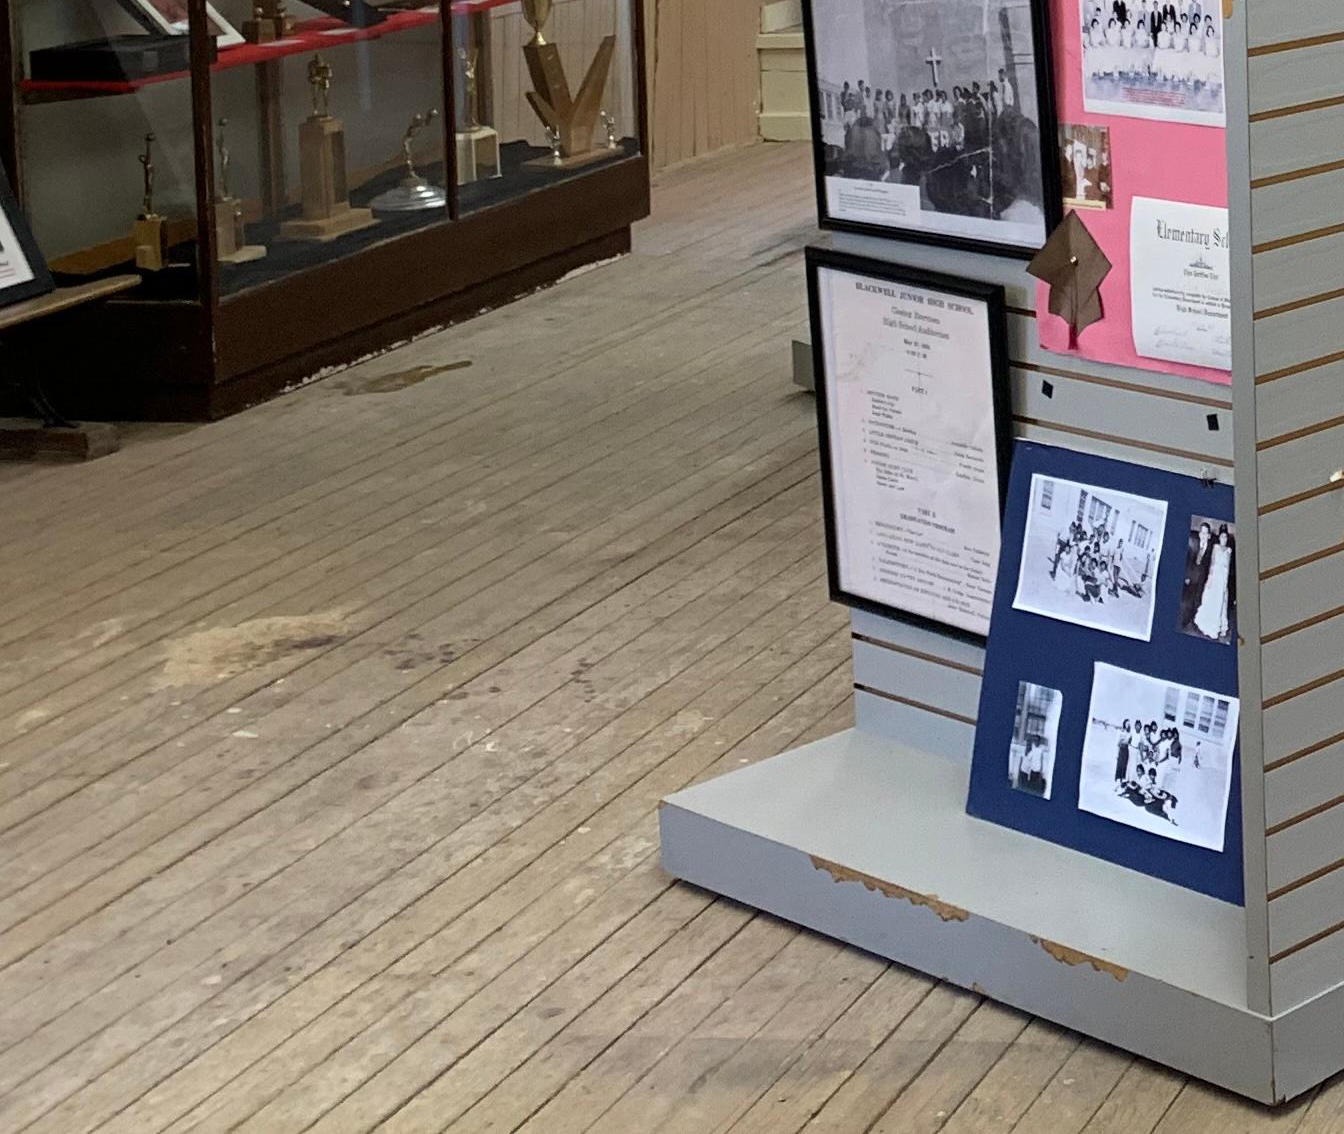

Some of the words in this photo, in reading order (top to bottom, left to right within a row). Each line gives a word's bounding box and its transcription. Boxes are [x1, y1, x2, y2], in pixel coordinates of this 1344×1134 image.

[1156, 218, 1210, 250] Elementary
[855, 281, 897, 298] BLACKWELL
[899, 291, 924, 305] JUNIOR
[927, 298, 945, 309] HIGH
